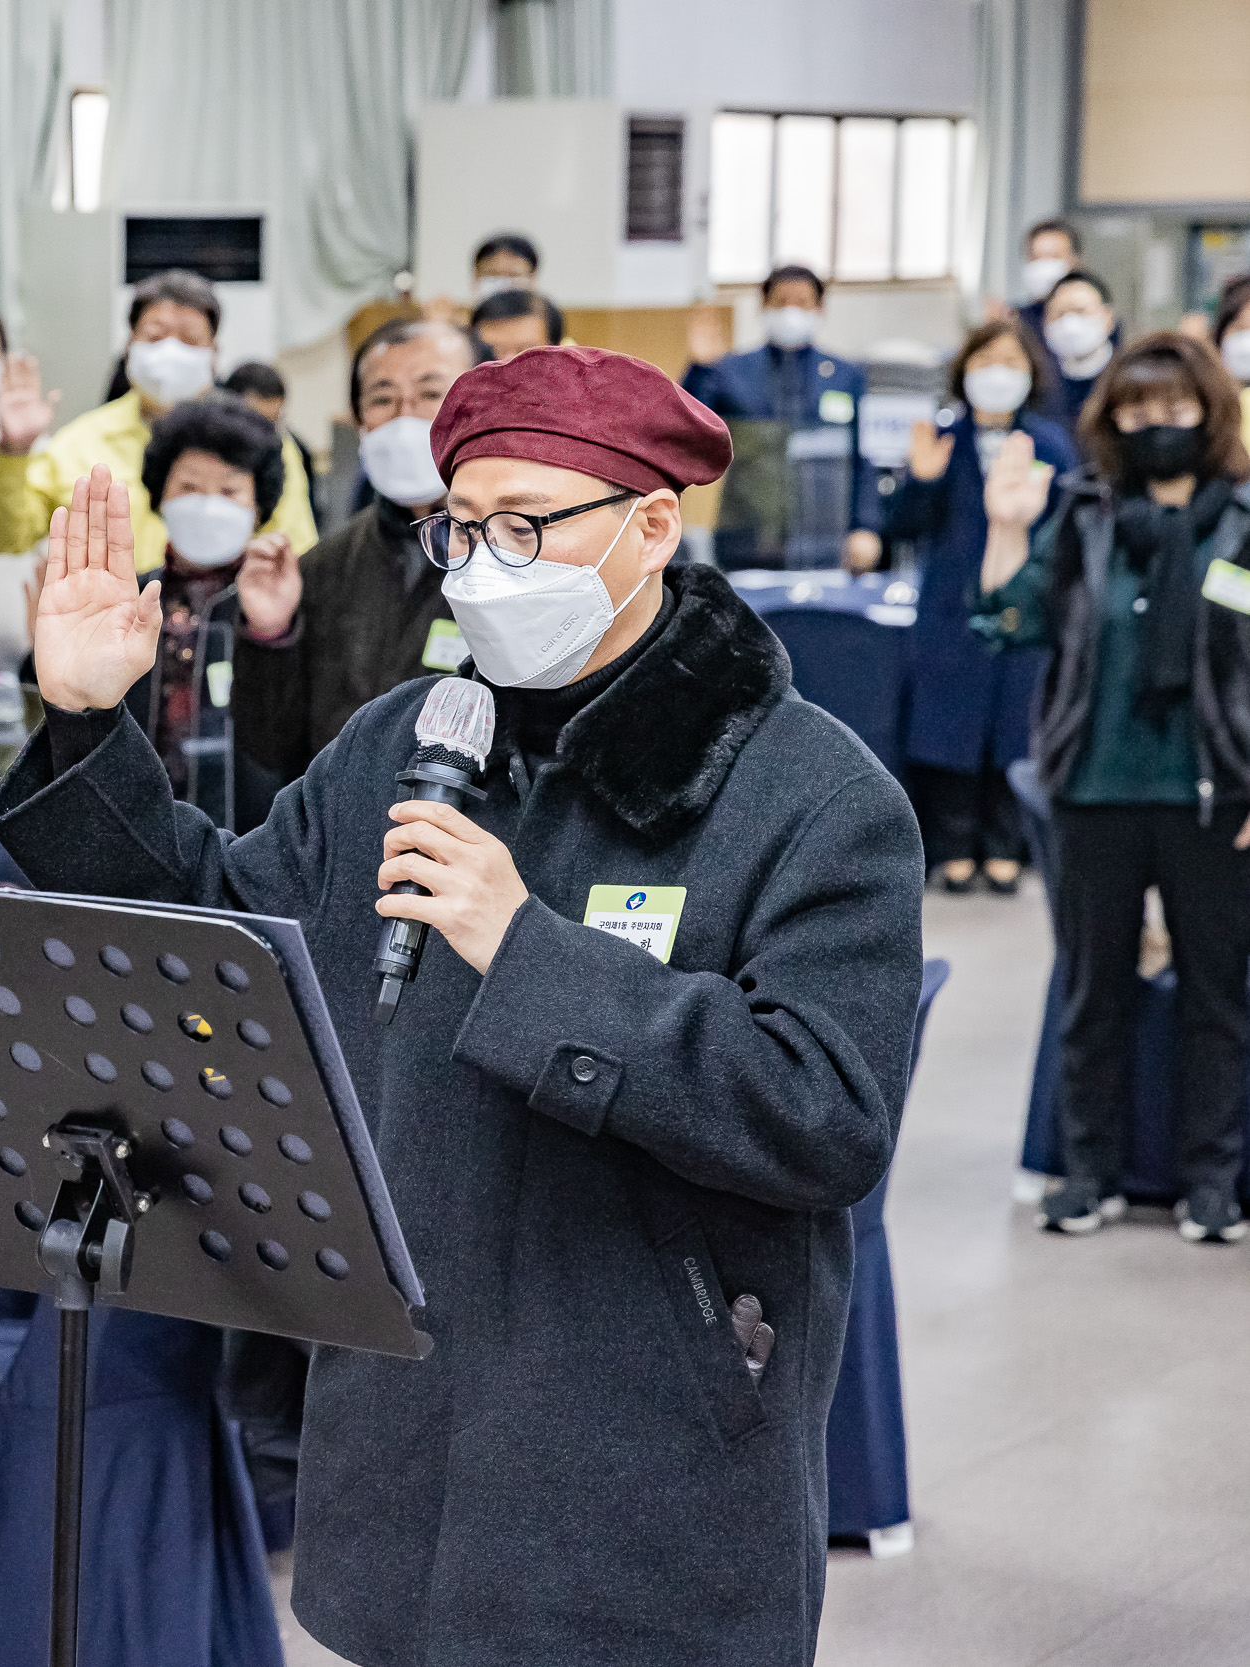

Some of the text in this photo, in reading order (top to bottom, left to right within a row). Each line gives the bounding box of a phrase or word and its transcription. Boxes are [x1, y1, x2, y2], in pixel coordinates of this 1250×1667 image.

[541, 612, 580, 652] care ON
[598, 920, 663, 931] 구의제1동 주민자치회
[683, 1257, 717, 1325] CAMBRIDGE
